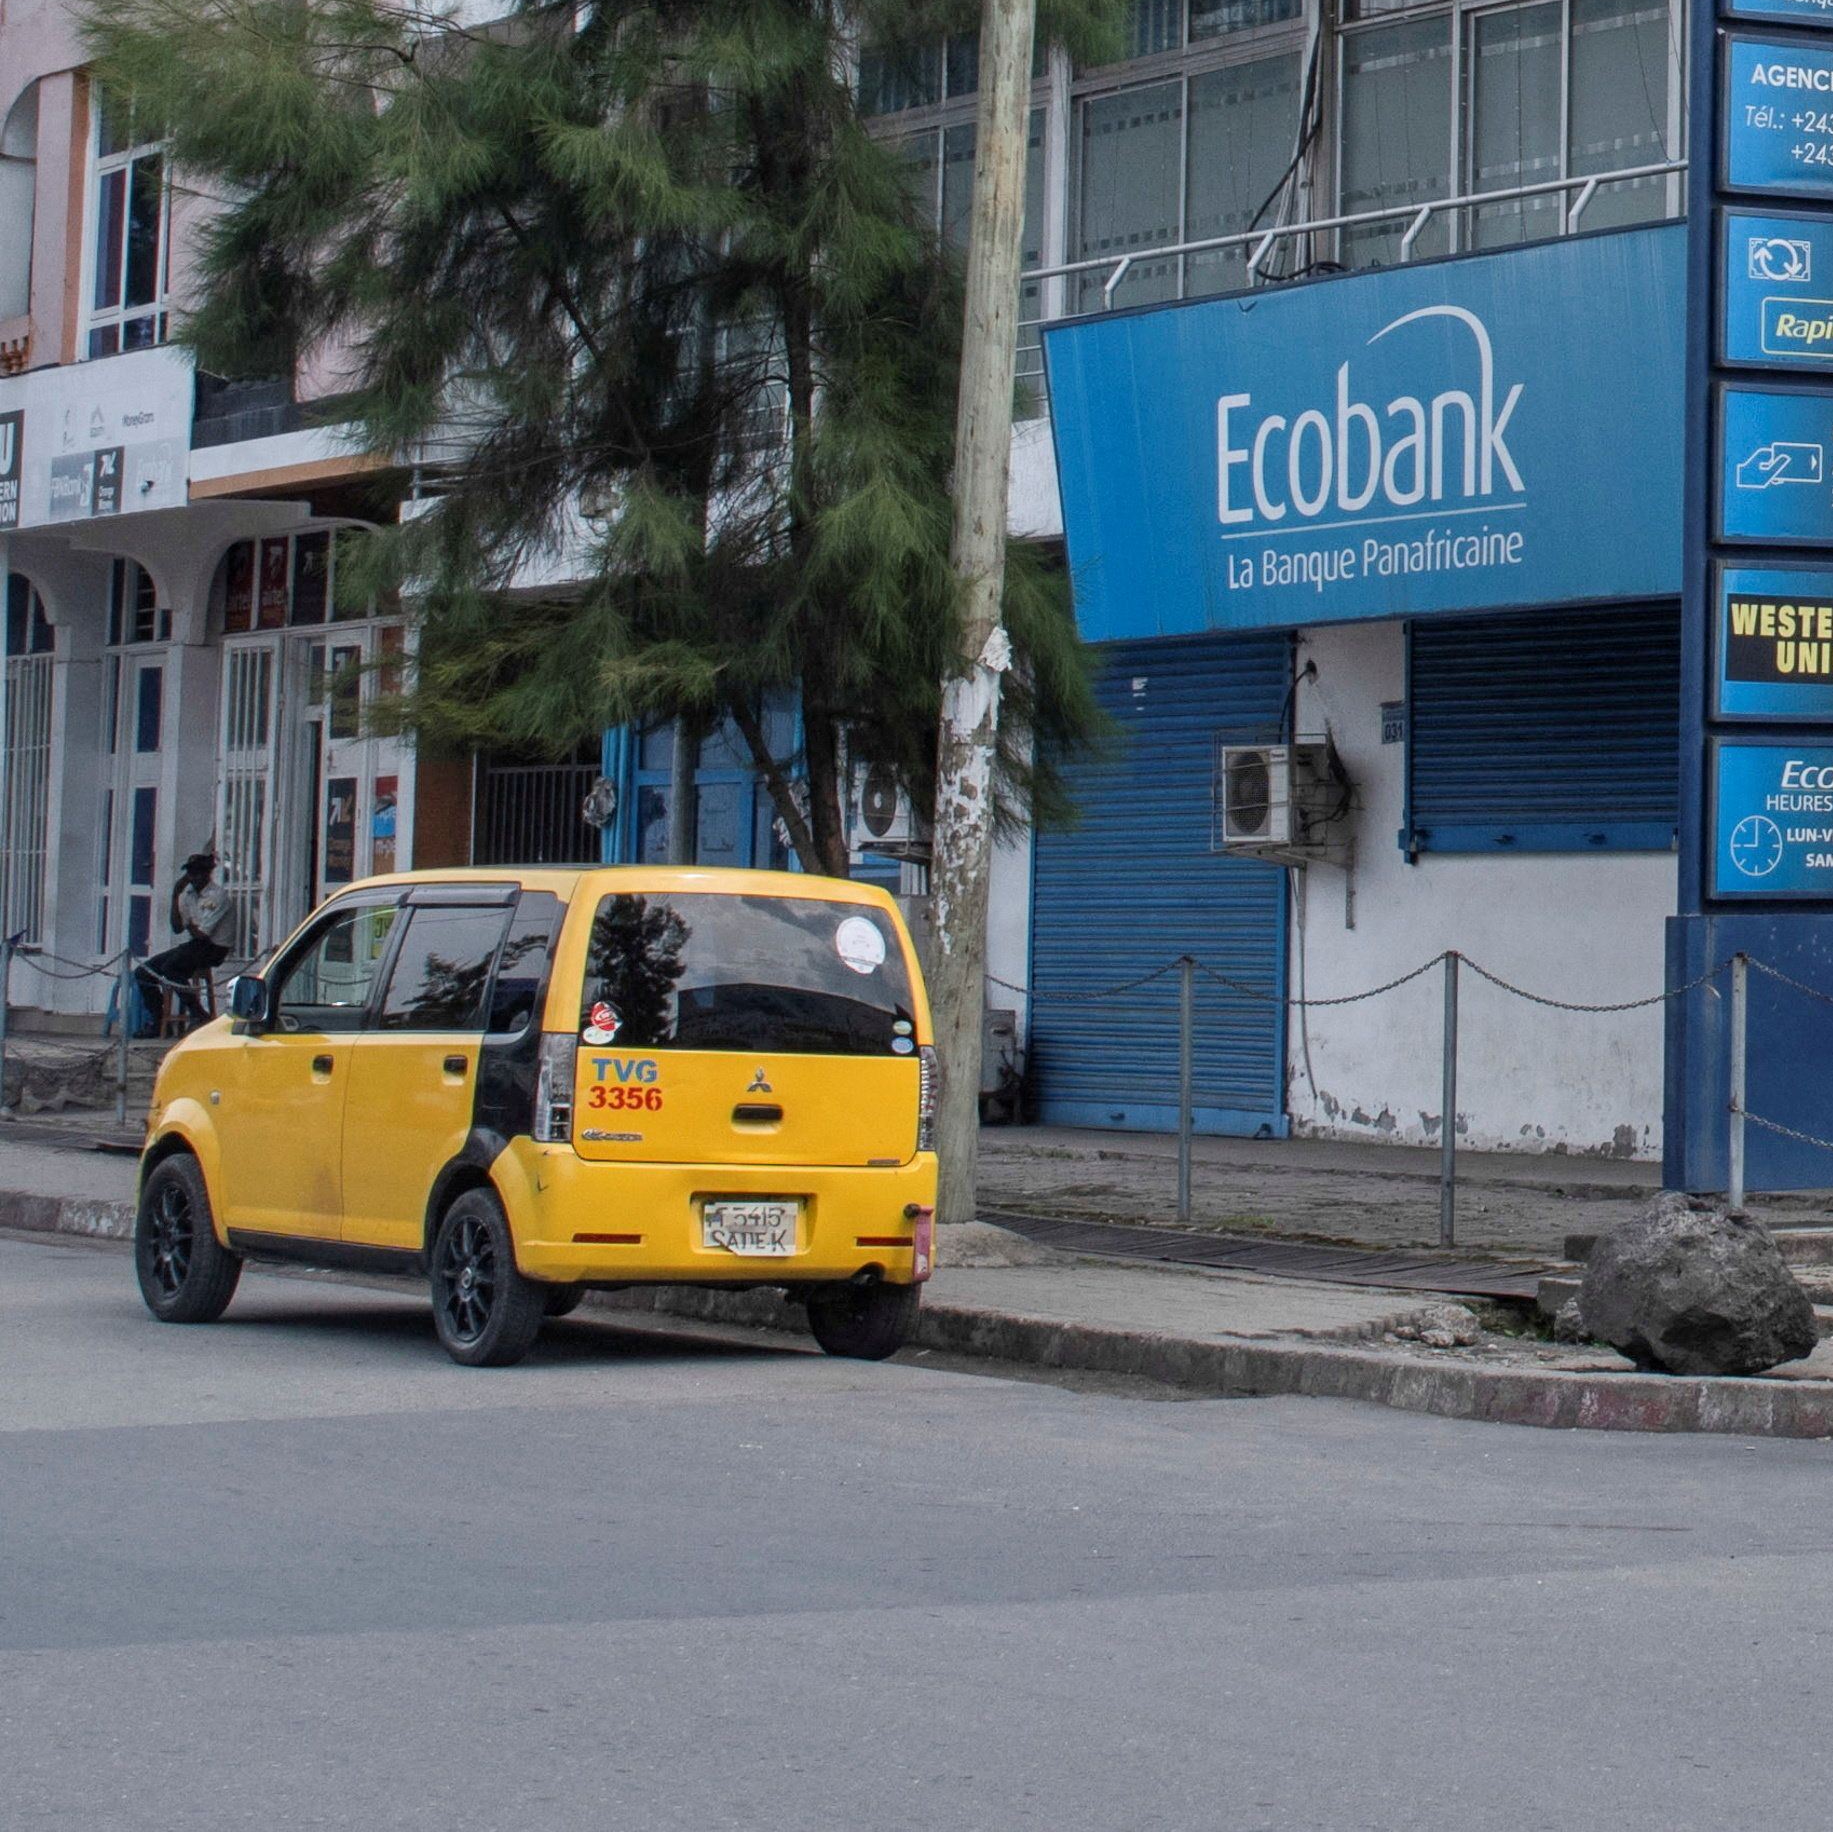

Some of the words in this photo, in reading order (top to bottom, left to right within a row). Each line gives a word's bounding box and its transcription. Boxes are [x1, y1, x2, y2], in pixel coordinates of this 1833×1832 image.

[1217, 304, 1526, 525] Ecobank
[1228, 554, 1253, 590] La
[1263, 546, 1355, 592] Banque
[1363, 525, 1523, 578] Panafricaine
[1766, 794, 1833, 813] HEURES
[591, 1057, 659, 1083] TVG
[588, 1085, 664, 1112] 3356
